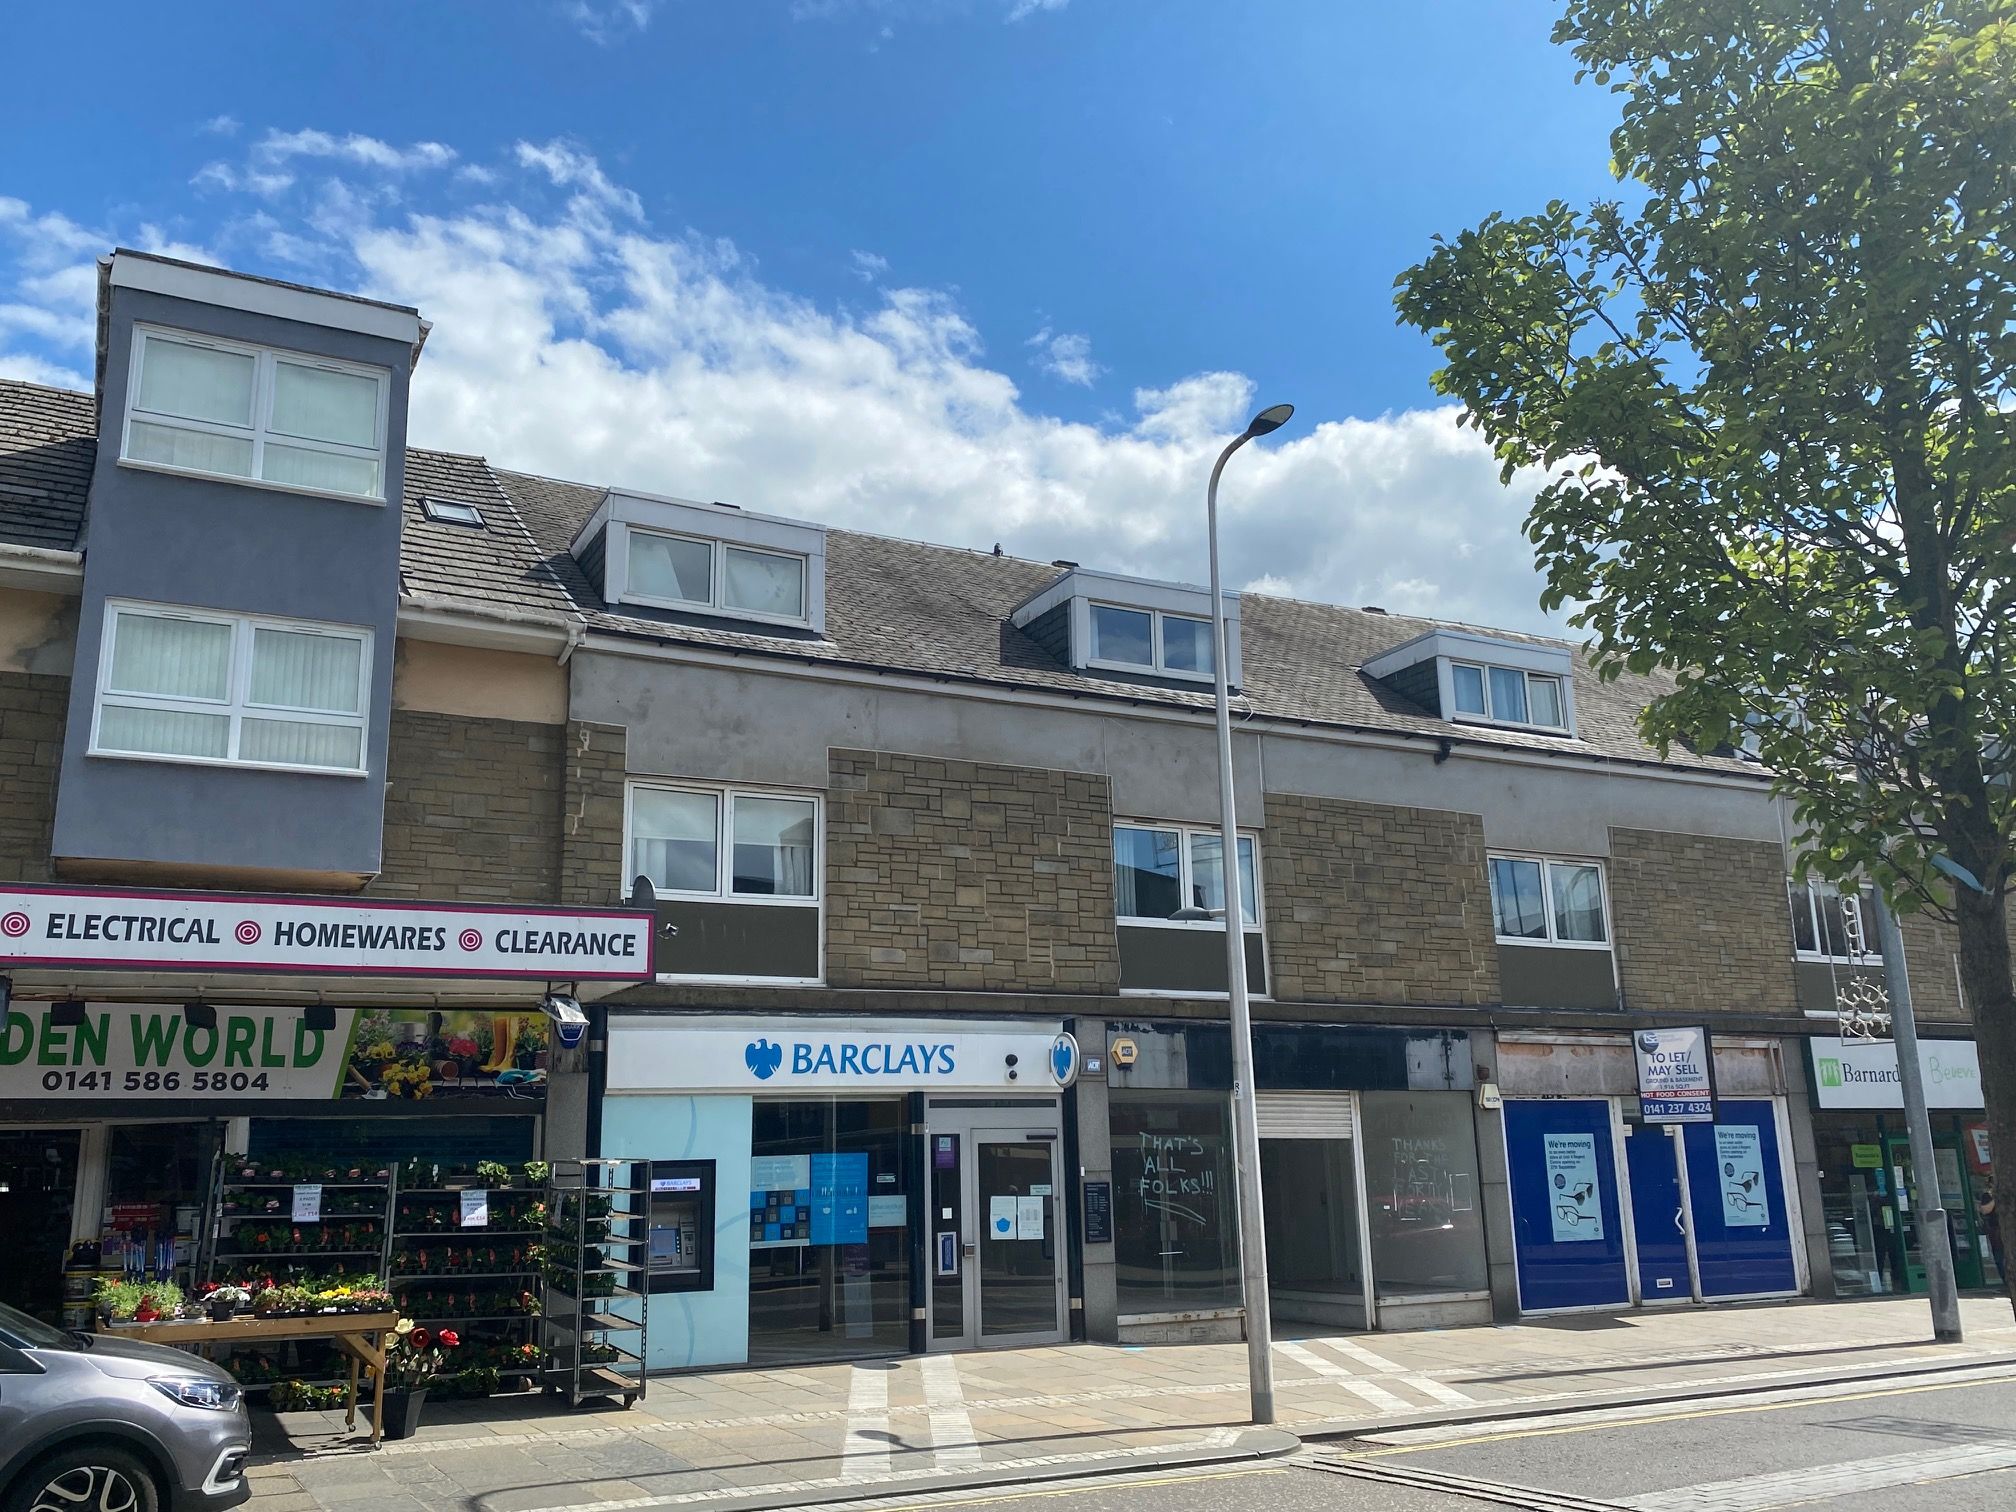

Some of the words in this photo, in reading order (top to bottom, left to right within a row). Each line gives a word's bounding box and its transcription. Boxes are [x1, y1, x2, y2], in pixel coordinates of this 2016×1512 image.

[46, 913, 221, 944] ELECTRICAL
[274, 921, 446, 951] HOMEWARES
[495, 929, 636, 957] CLEARANCE
[130, 1014, 325, 1068] WORLD
[791, 1044, 955, 1075] BARCLAYS
[1088, 1061, 1100, 1069] ADT
[1651, 1053, 1666, 1063] TO
[1648, 1065, 1671, 1076] MAY
[1675, 1064, 1699, 1075] SELL
[42, 1071, 111, 1091] 0141
[123, 1072, 180, 1090] 586
[191, 1072, 269, 1091] 5804
[1644, 1104, 1664, 1114] 0141
[1668, 1103, 1684, 1113] 237
[1688, 1102, 1711, 1112] 4324
[1139, 1131, 1204, 1155] THAT'S
[1735, 1132, 1756, 1140] moving
[1548, 1140, 1566, 1148] We're
[1568, 1140, 1591, 1149] moving
[1145, 1155, 1186, 1175] ALL
